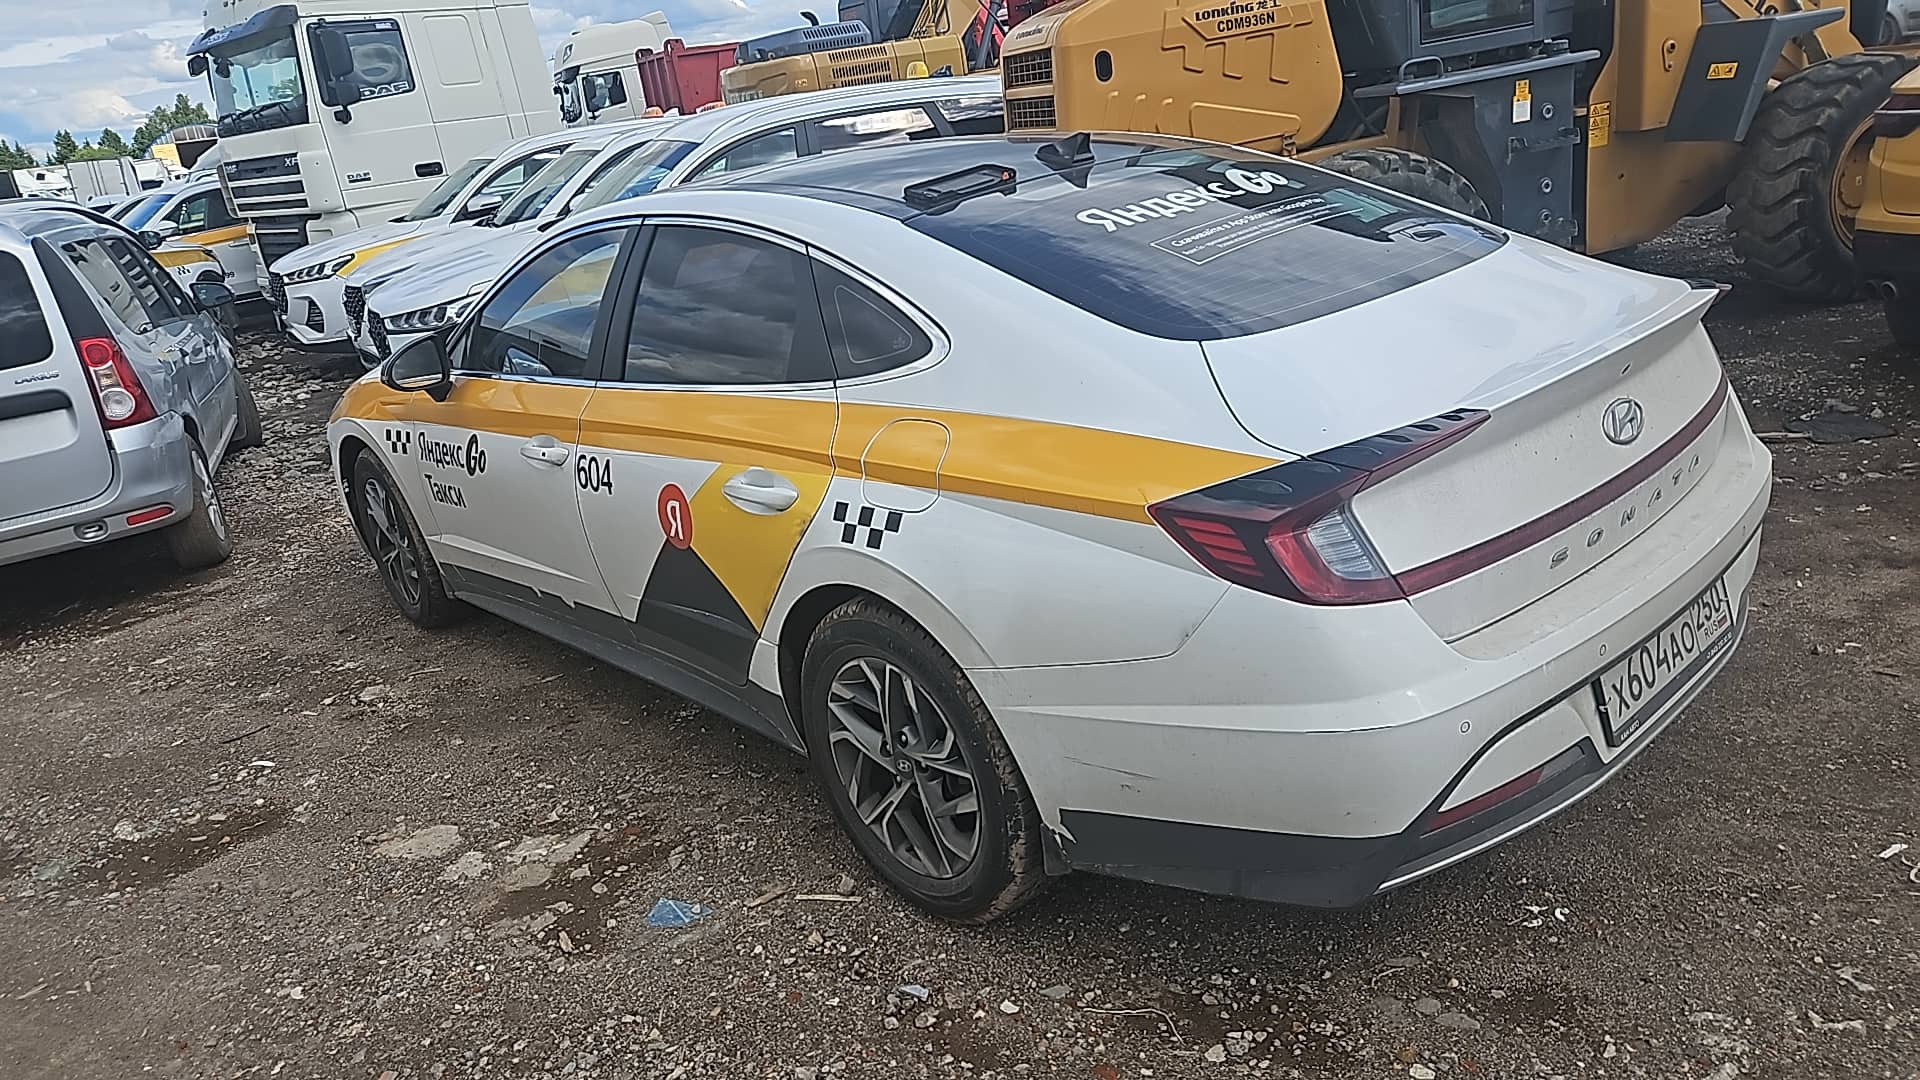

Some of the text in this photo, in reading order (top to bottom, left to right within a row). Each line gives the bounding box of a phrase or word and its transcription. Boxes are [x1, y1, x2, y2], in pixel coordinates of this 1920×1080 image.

[1217, 11, 1275, 32] CDM936N
[360, 81, 409, 99] DAF
[1076, 182, 1244, 232] Яндекс
[418, 432, 465, 469] Яндекс
[424, 474, 467, 509] Такси
[576, 454, 613, 495] 604
[1692, 583, 1721, 632] 250
[1704, 619, 1719, 640] RUS
